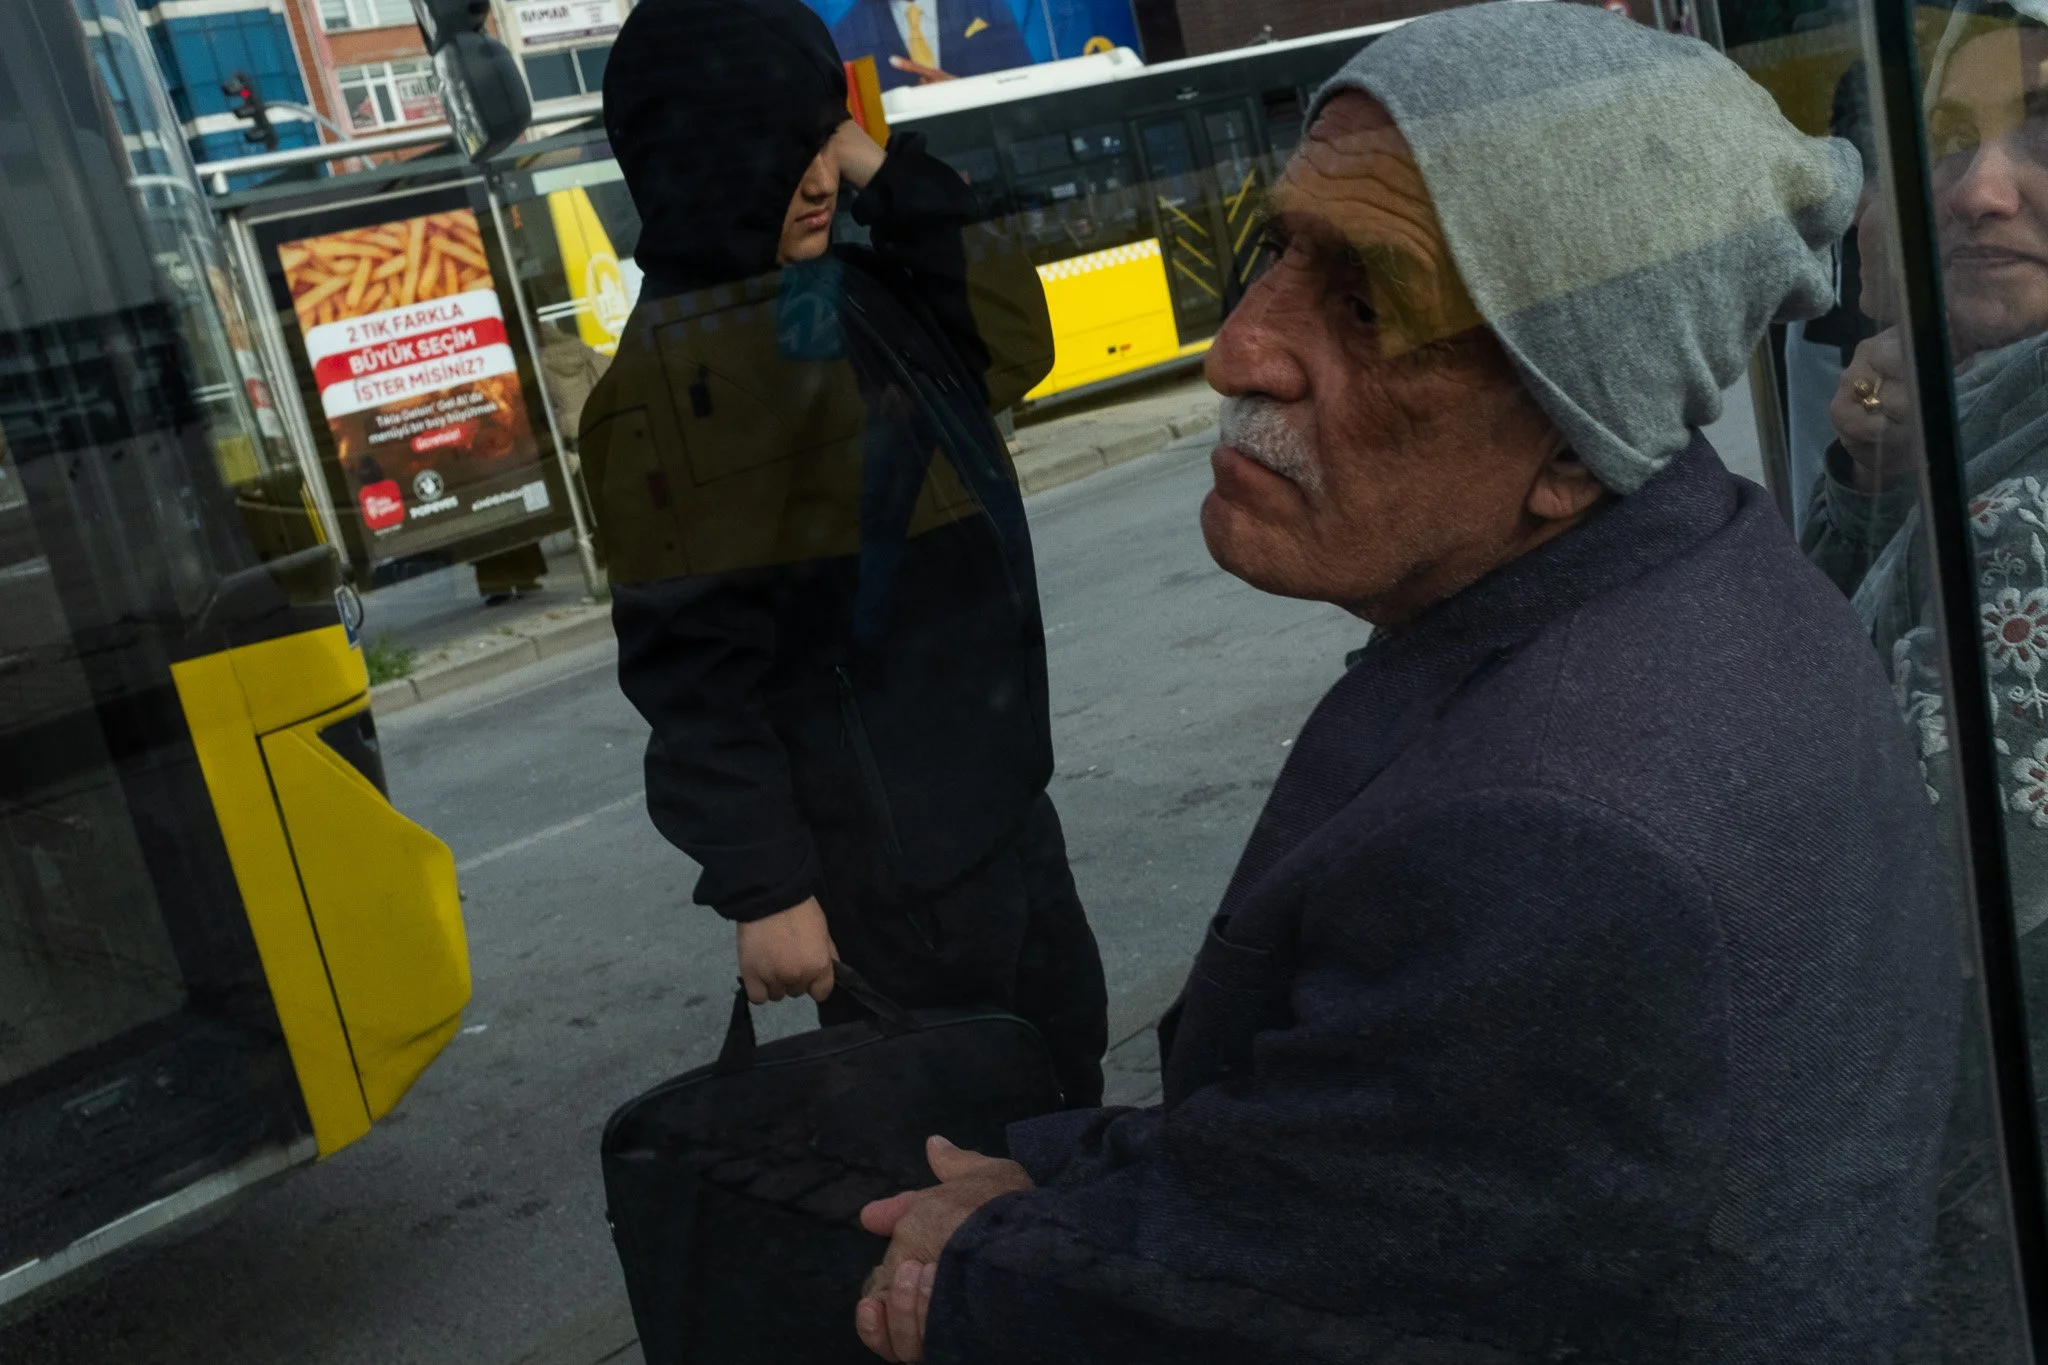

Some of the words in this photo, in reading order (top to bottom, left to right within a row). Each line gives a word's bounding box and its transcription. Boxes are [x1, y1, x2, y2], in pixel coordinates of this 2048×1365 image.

[346, 327, 358, 343] 2
[361, 321, 389, 340] TIK
[392, 302, 465, 333] FARKLA
[348, 341, 418, 375] BÜYÜK
[417, 327, 478, 357] SEÇİM
[355, 377, 406, 404] İSTER
[409, 356, 486, 389] MİSİNİZ?
